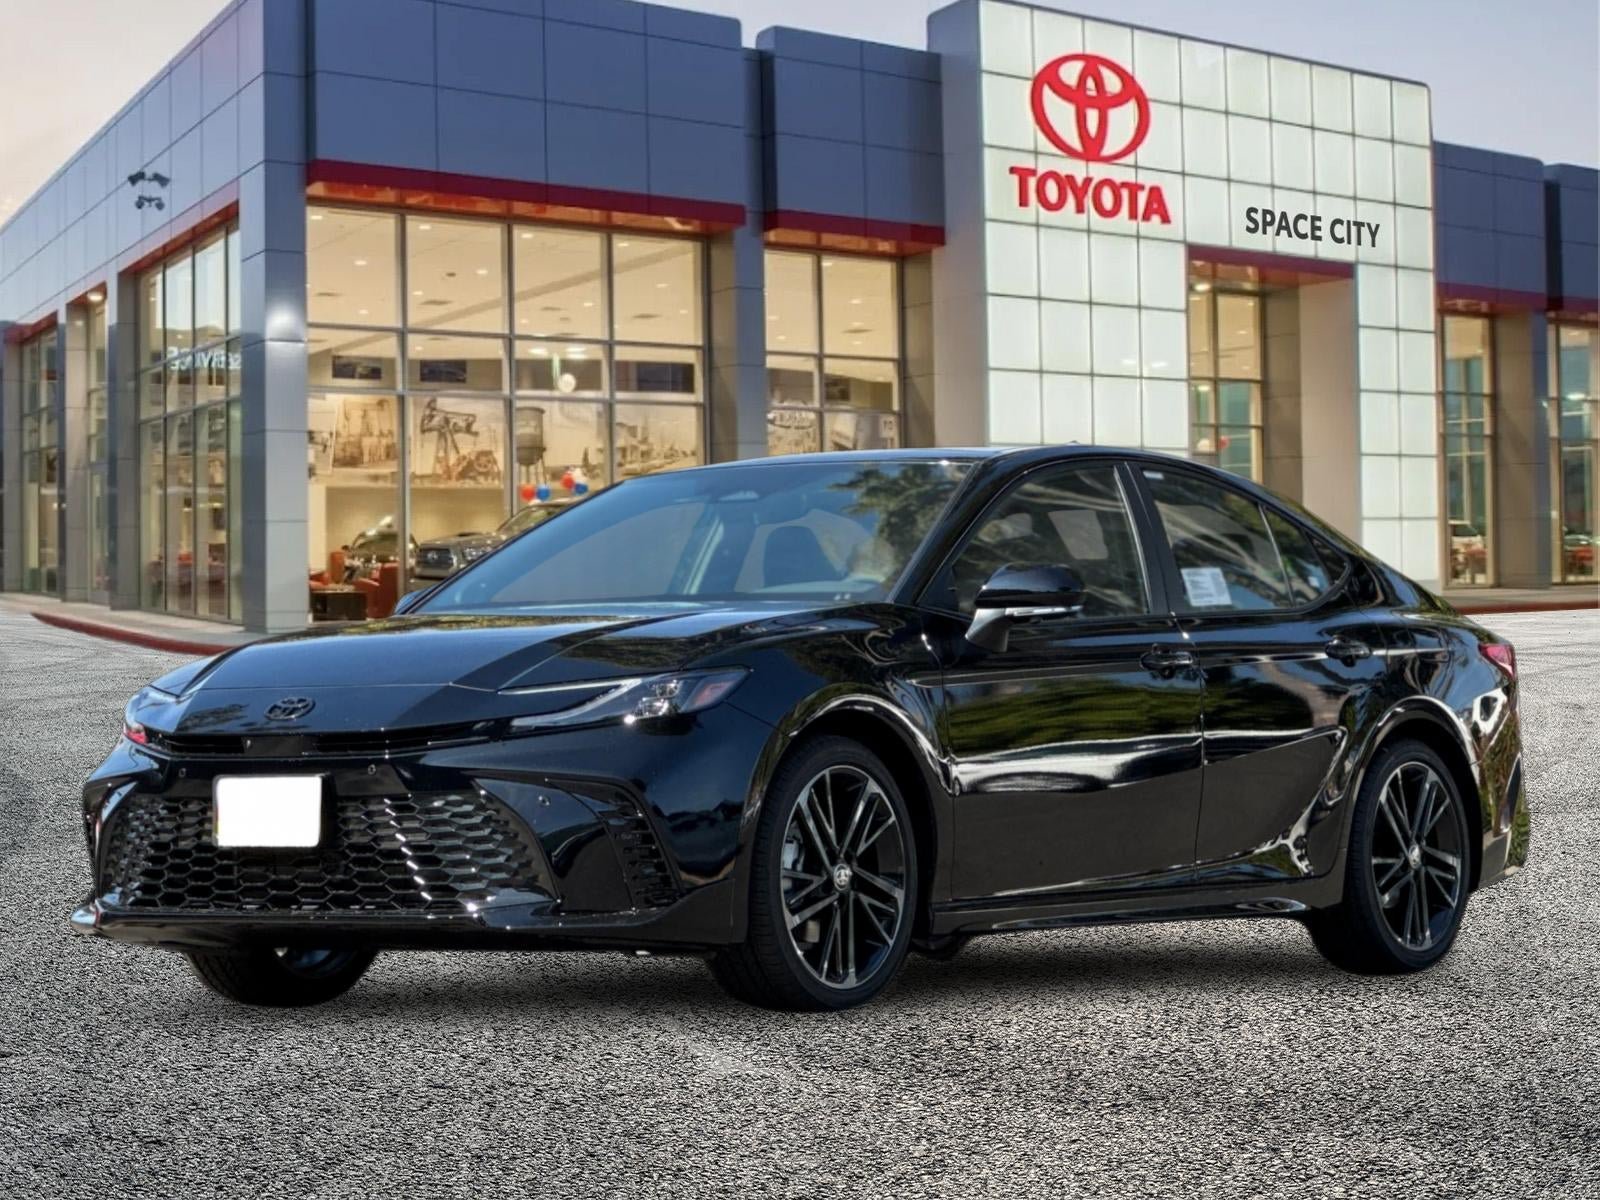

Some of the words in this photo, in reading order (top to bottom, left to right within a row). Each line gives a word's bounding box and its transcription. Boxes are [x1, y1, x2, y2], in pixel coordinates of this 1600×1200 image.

[1009, 166, 1171, 224] TOYOTA
[1245, 206, 1322, 241] SPACE
[1329, 218, 1380, 247] CITY
